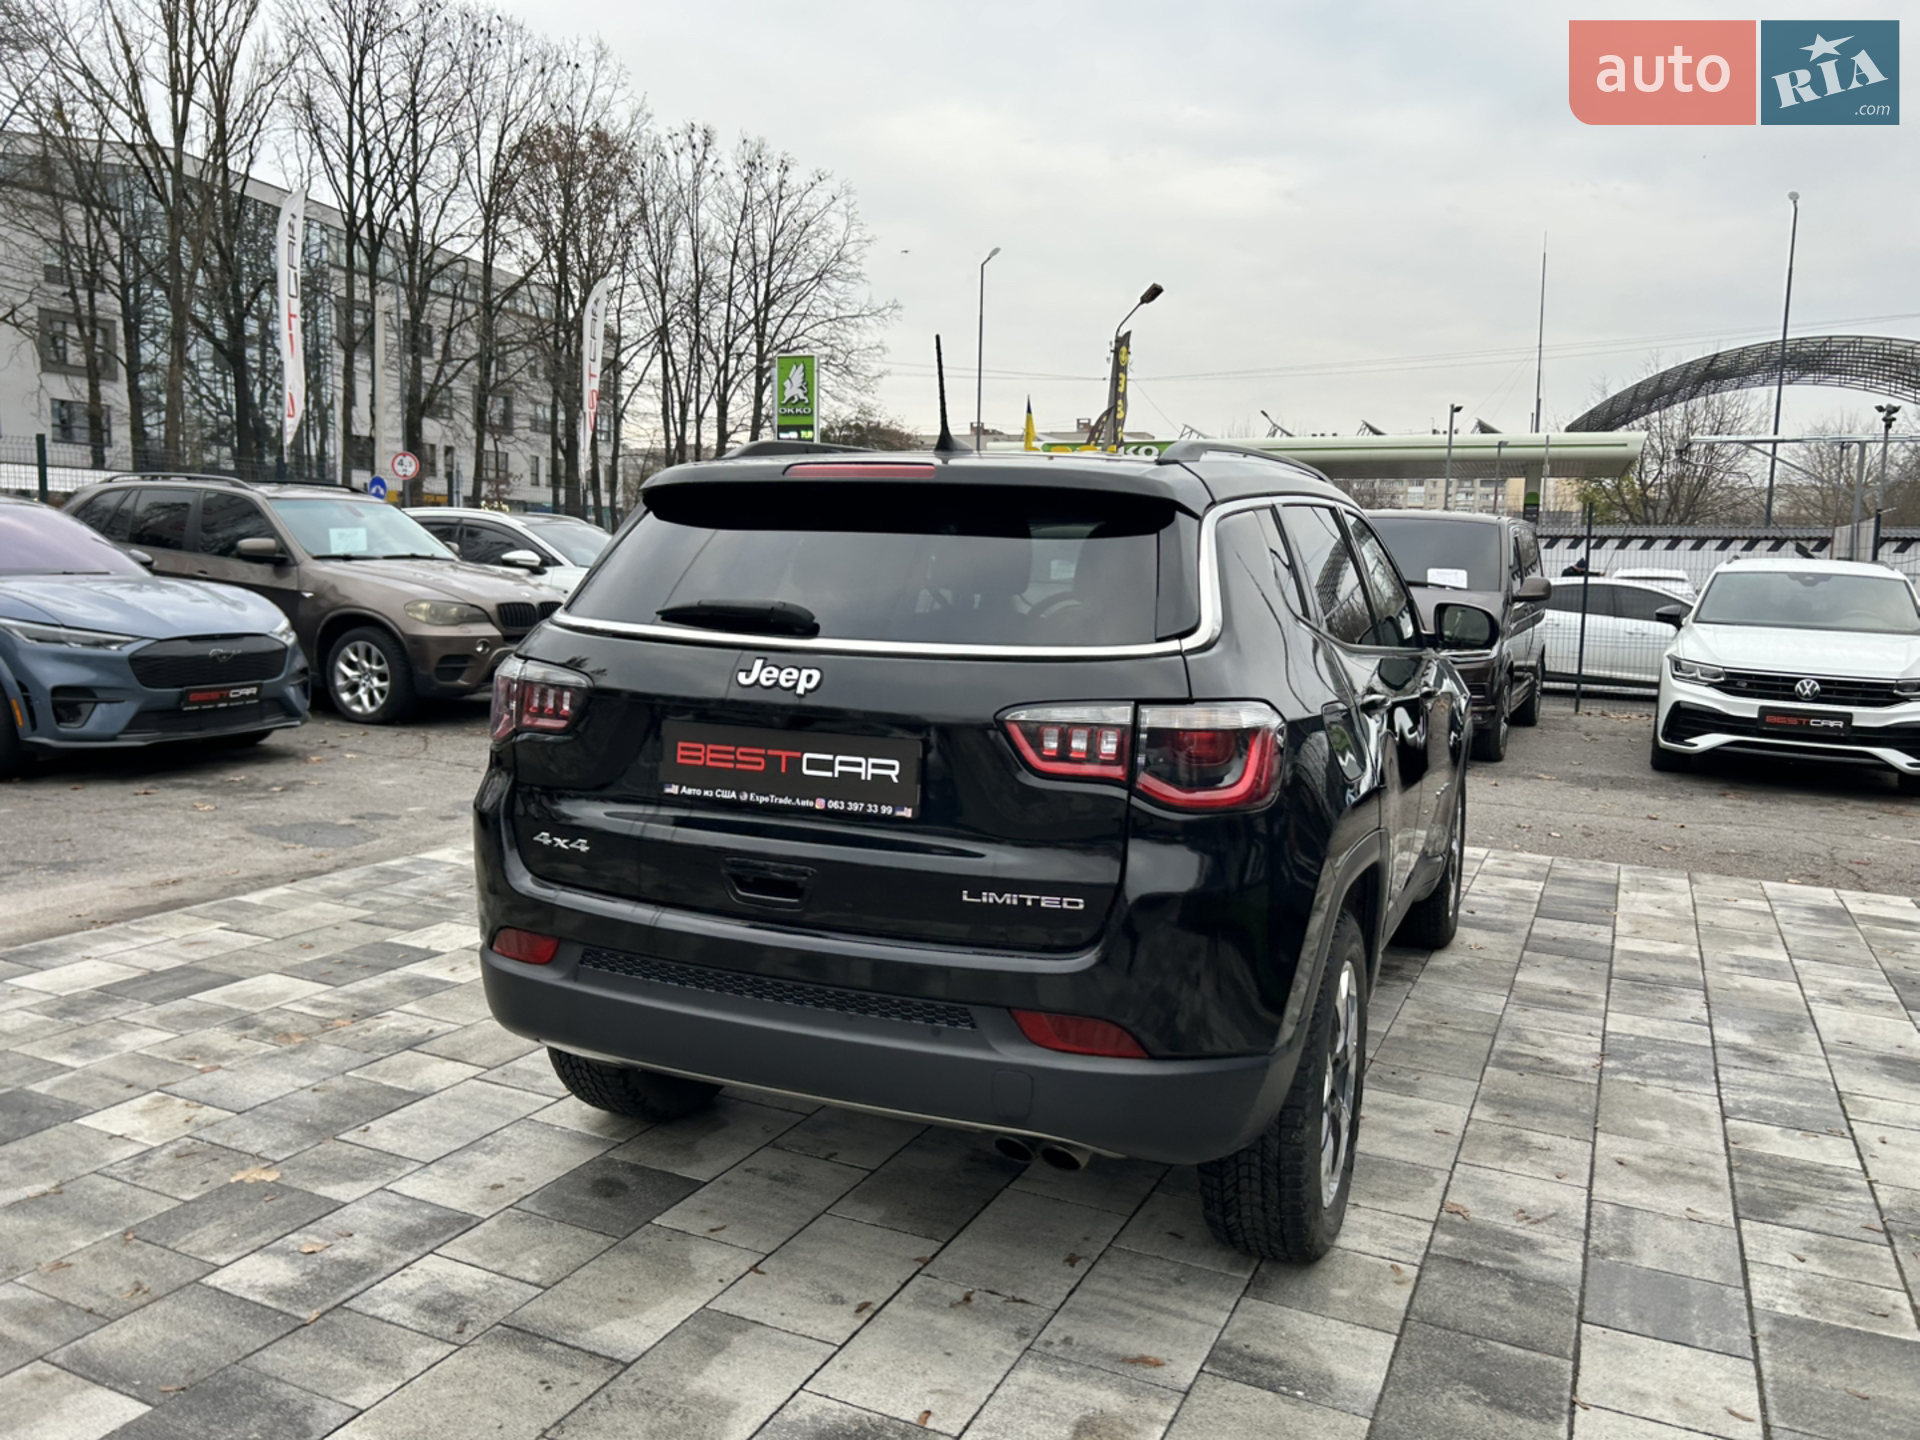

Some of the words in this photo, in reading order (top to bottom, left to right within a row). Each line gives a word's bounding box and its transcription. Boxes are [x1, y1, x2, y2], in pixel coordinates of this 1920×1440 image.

[737, 658, 821, 695] Jeep
[188, 687, 258, 702] BESTCAR
[1765, 715, 1844, 729] BESTCAR
[676, 741, 900, 783] BESTCAR
[680, 785, 701, 796] Авто
[703, 788, 713, 797] из
[715, 788, 737, 799] США
[749, 793, 814, 808] ExpoTrade.Auto
[827, 800, 845, 810] 063
[847, 802, 864, 812] 397
[866, 803, 879, 813] 33
[881, 805, 893, 815] 99
[533, 831, 590, 853] 4x4
[962, 890, 1085, 910] LIMITED
